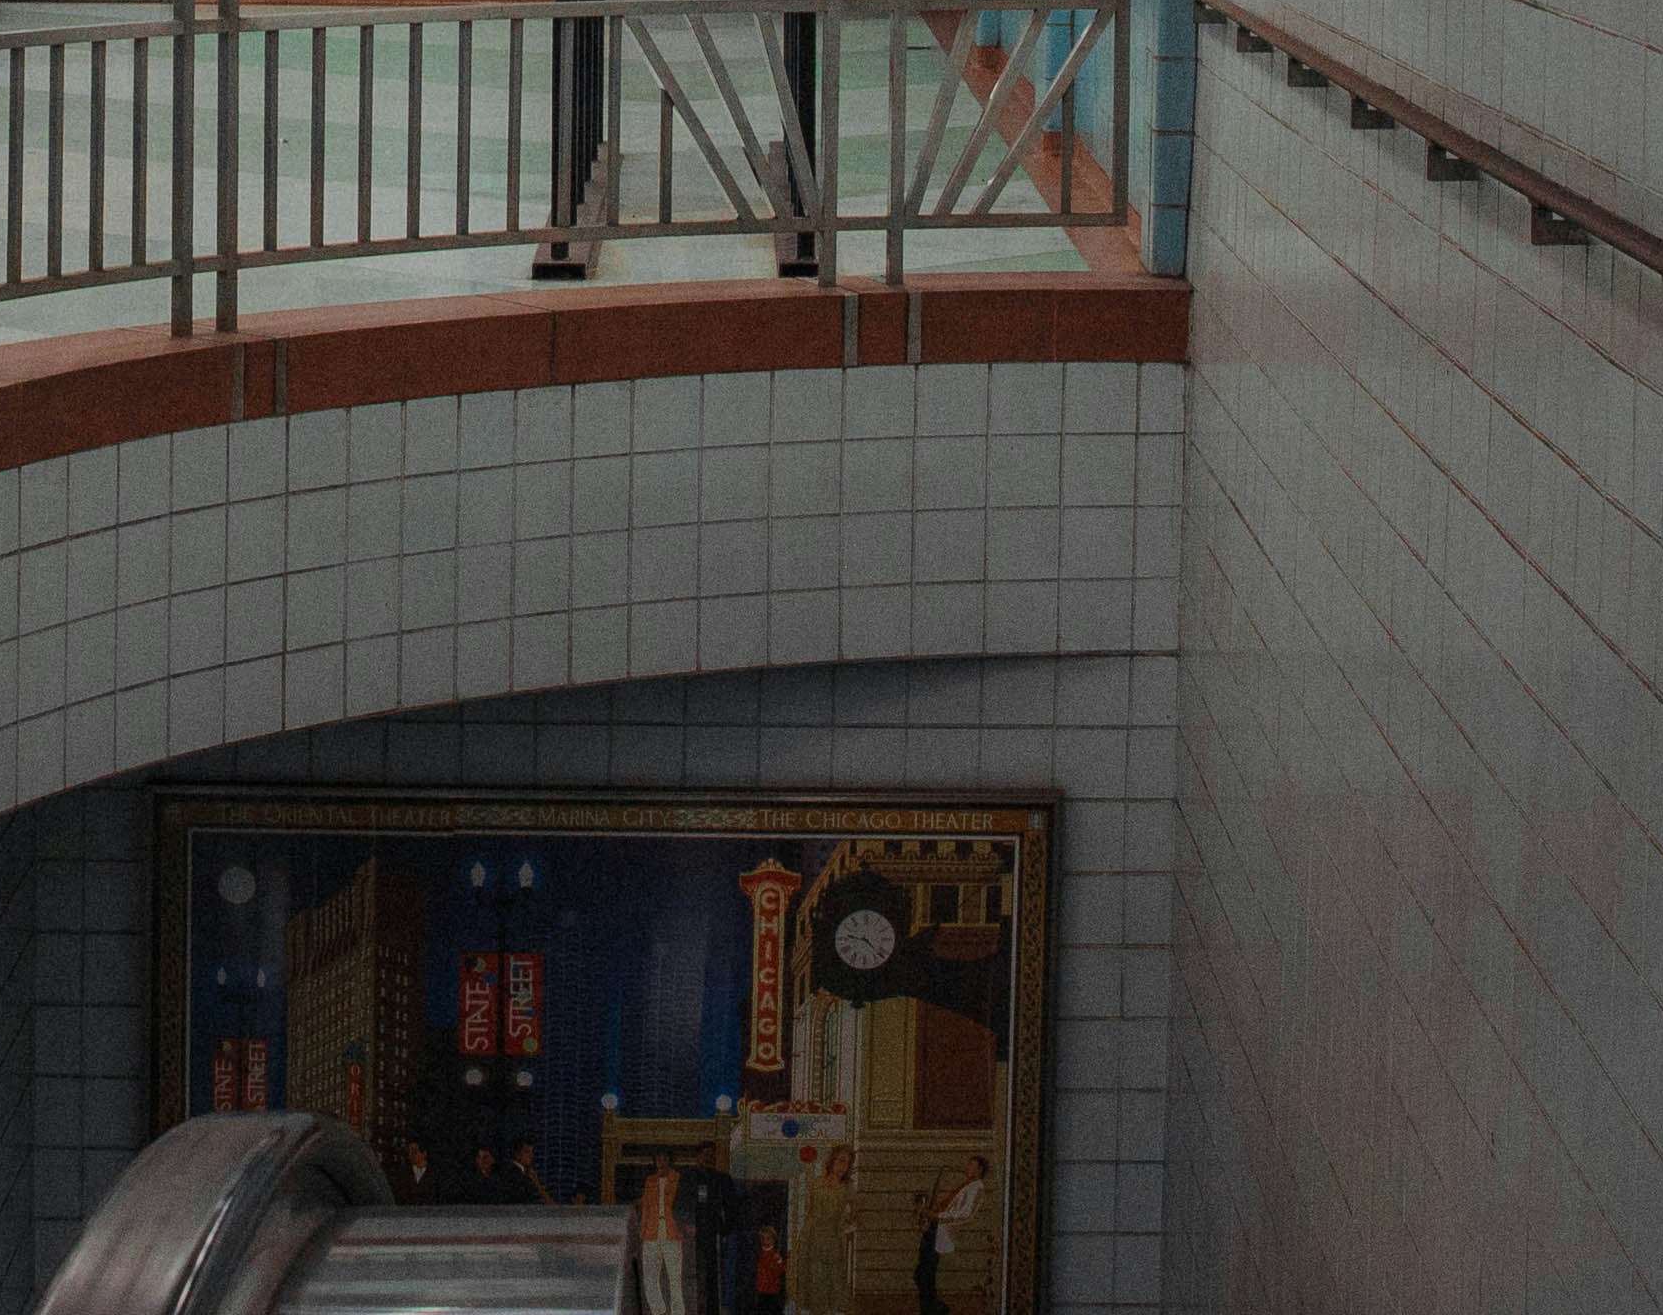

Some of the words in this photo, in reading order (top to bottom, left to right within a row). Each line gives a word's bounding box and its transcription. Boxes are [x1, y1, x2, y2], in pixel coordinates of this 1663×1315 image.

[370, 804, 452, 826] THEATER
[538, 806, 611, 827] MARINA
[621, 808, 671, 828] CITY
[761, 809, 794, 828] THE
[804, 809, 901, 829] CHICAGO
[911, 809, 994, 830] THEATER
[758, 884, 783, 1063] CHICAGO
[462, 975, 492, 1053] STATE
[507, 955, 539, 1039] STREET
